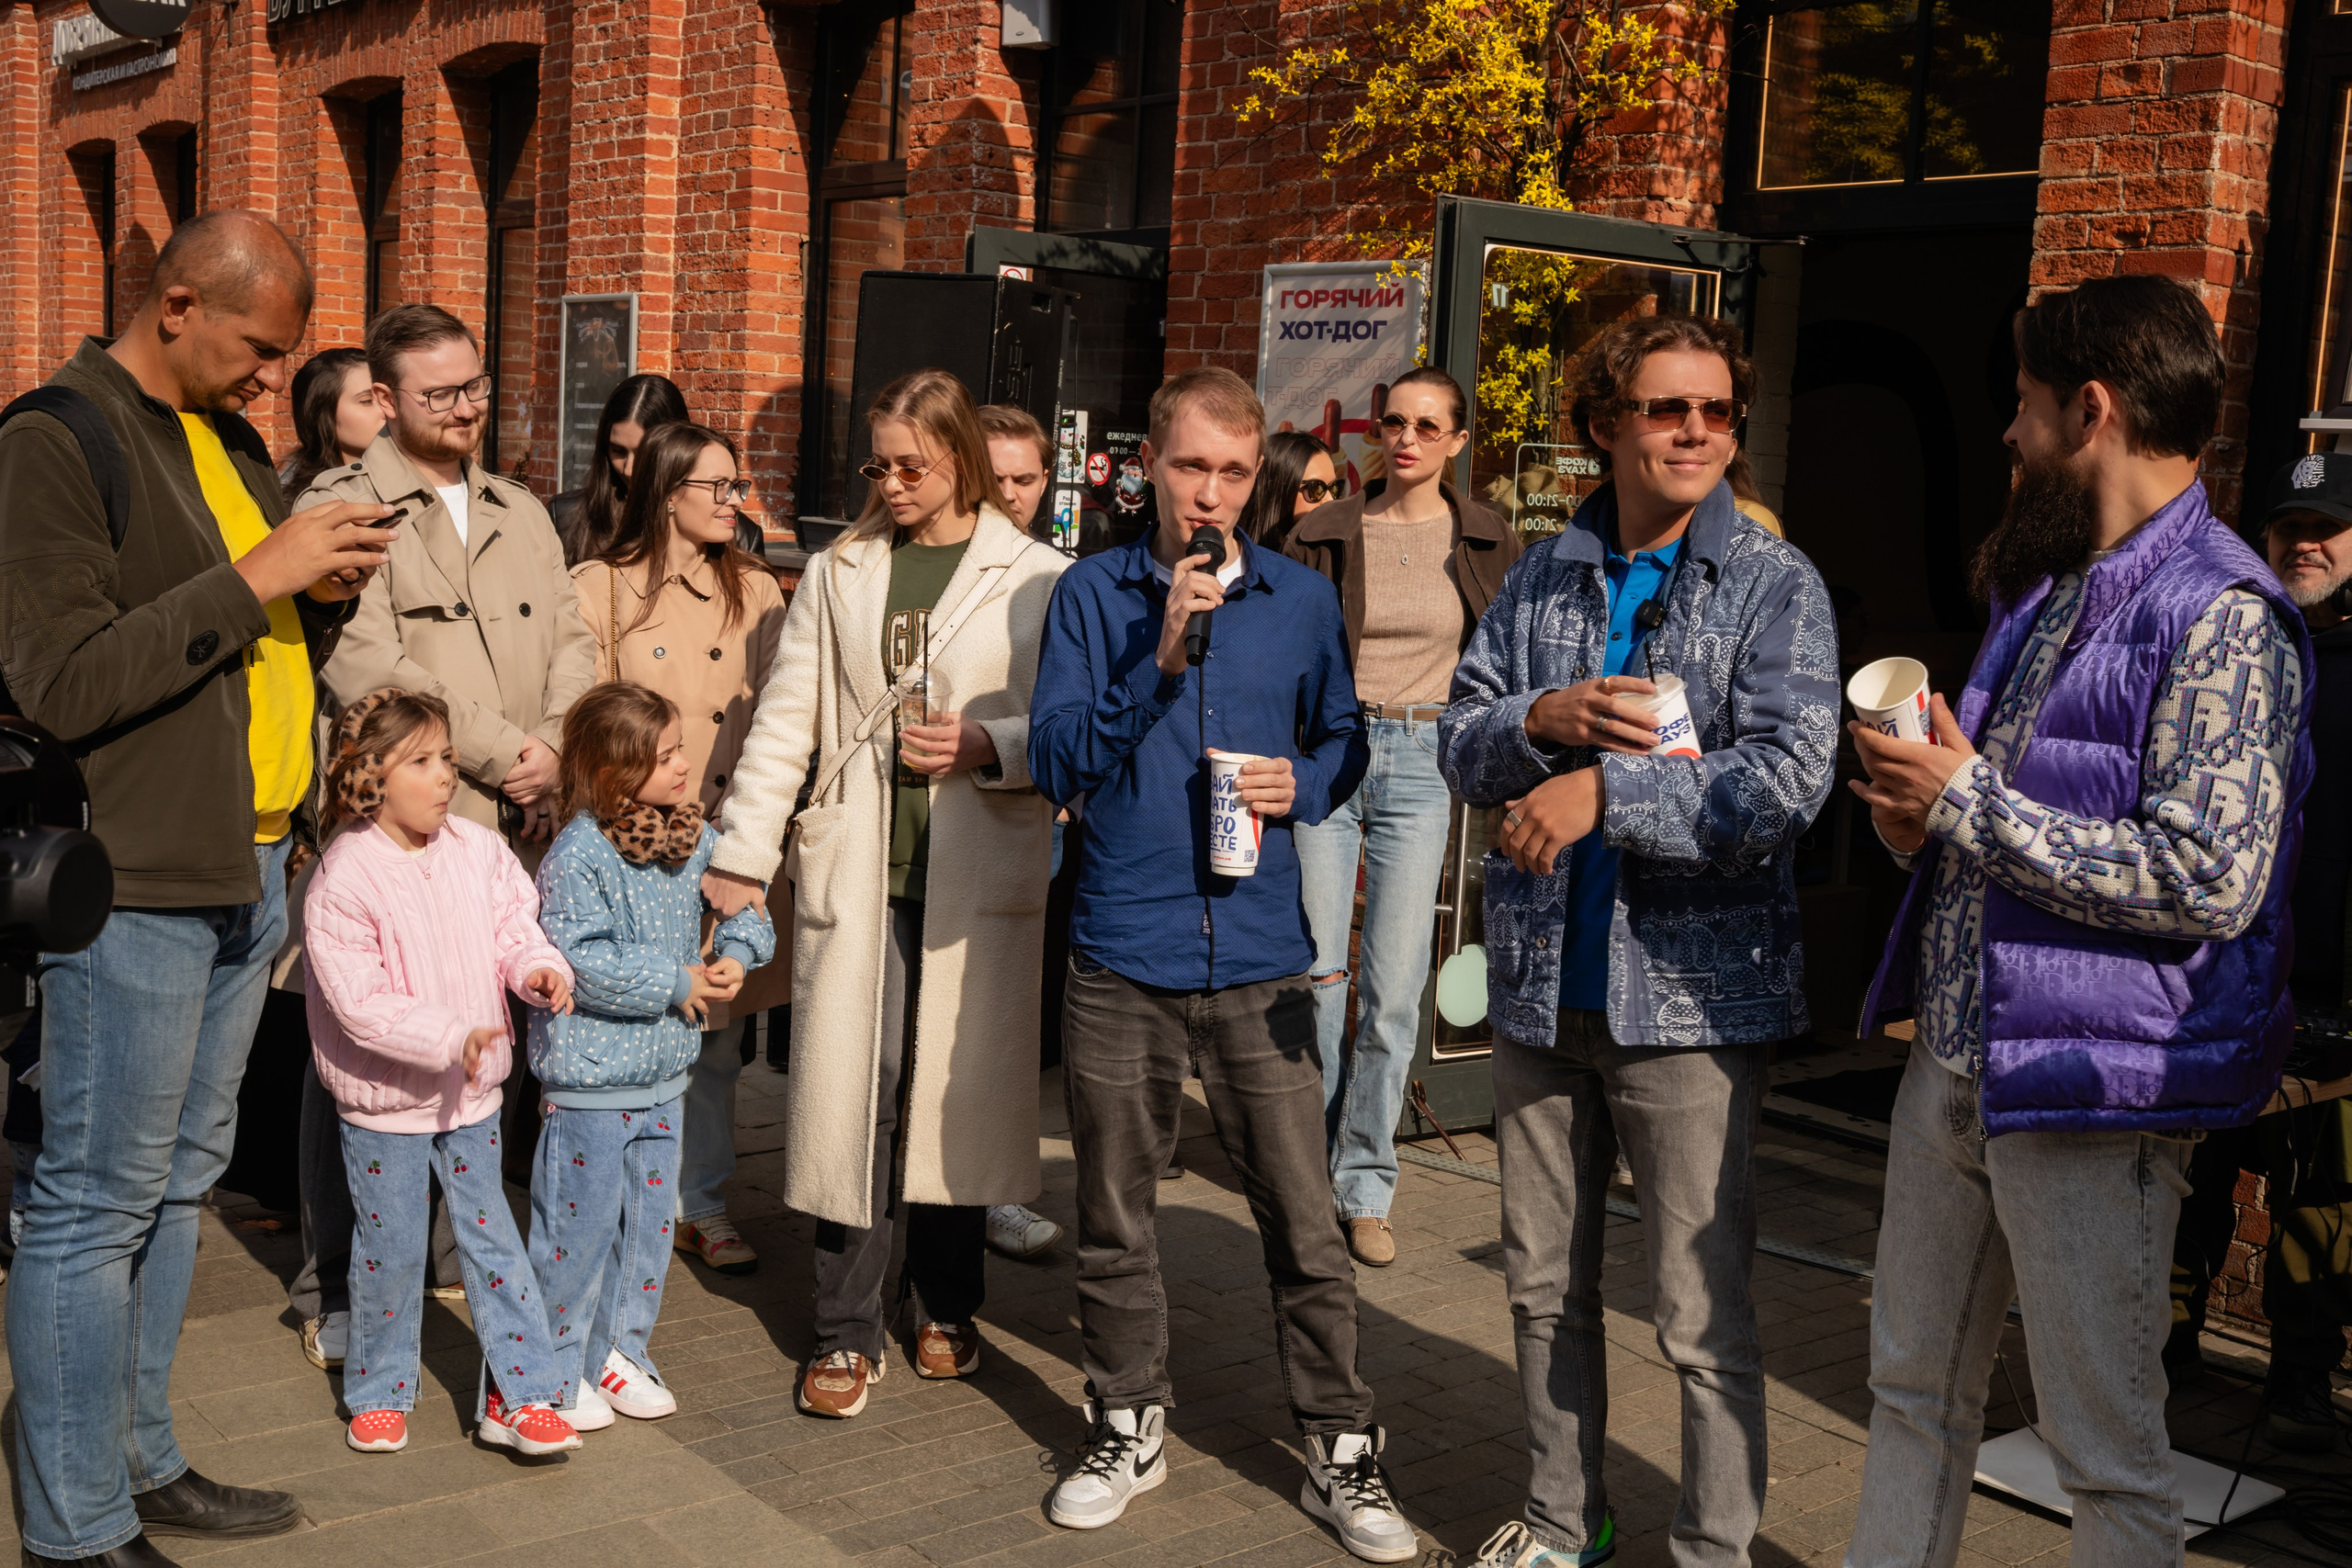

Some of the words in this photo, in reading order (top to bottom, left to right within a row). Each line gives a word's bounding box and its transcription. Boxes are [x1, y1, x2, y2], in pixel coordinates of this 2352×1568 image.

[73, 64, 120, 91] КОНДИТЕРСКАЯ
[127, 48, 176, 76] ГАСТРОНОМИЯ
[1281, 283, 1404, 309] ГОРЯЧИЙ
[1278, 321, 1387, 343] ХОТ-ДОГ
[1275, 354, 1401, 378] ГОРЯЧИЙ
[1654, 712, 1690, 736] ОФЕ
[1660, 724, 1690, 745] АУЗ
[1211, 773, 1234, 795] АЙ
[1211, 795, 1238, 813] АТЬ
